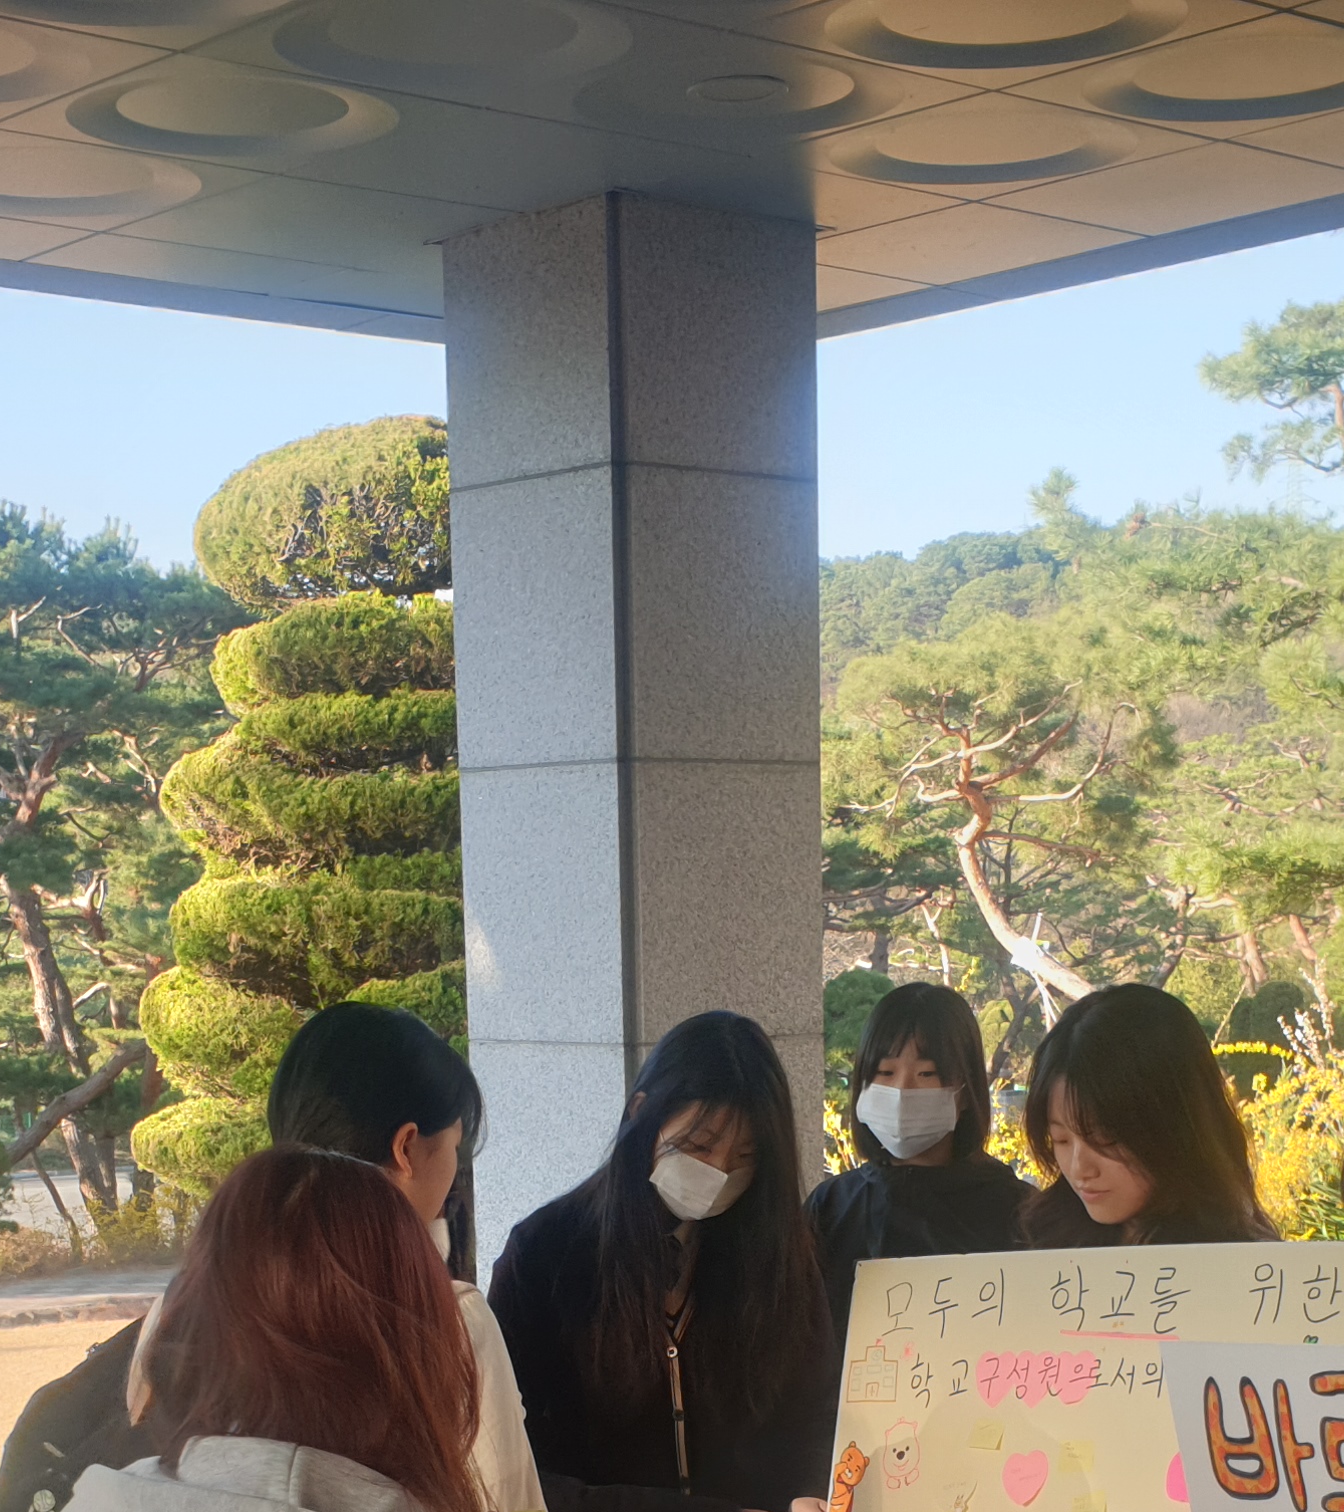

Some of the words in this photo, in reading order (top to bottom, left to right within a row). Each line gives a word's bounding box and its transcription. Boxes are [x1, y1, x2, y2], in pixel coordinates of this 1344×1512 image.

[881, 1267, 1006, 1339] 모두의
[1050, 1264, 1192, 1335] 학교를
[1249, 1263, 1343, 1326] 위한
